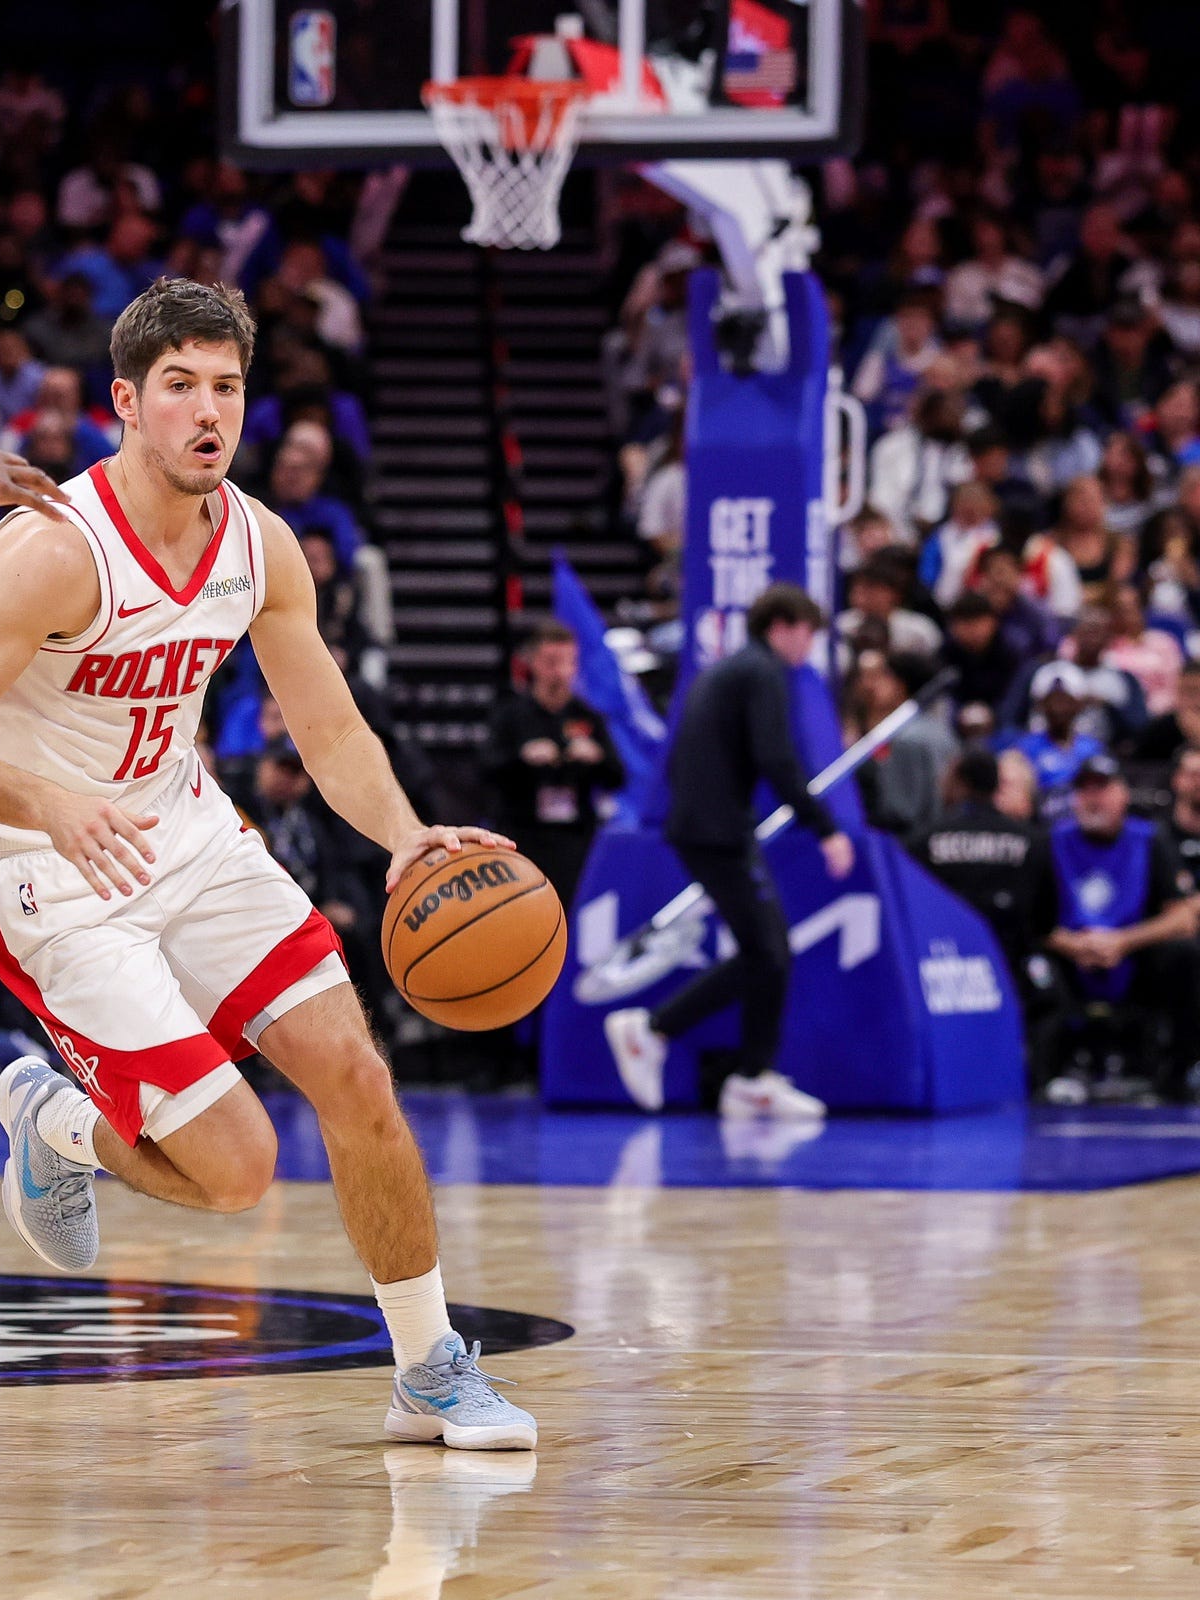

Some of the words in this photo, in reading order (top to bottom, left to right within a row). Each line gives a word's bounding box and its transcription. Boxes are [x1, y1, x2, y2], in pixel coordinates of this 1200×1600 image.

[709, 498, 773, 550] GET
[202, 575, 251, 592] MEMORIAL
[202, 582, 251, 599] HERMANN
[64, 638, 234, 699] ROCKET
[113, 703, 179, 781] 15
[929, 831, 1029, 866] SECURITY
[403, 860, 520, 932] Wilson
